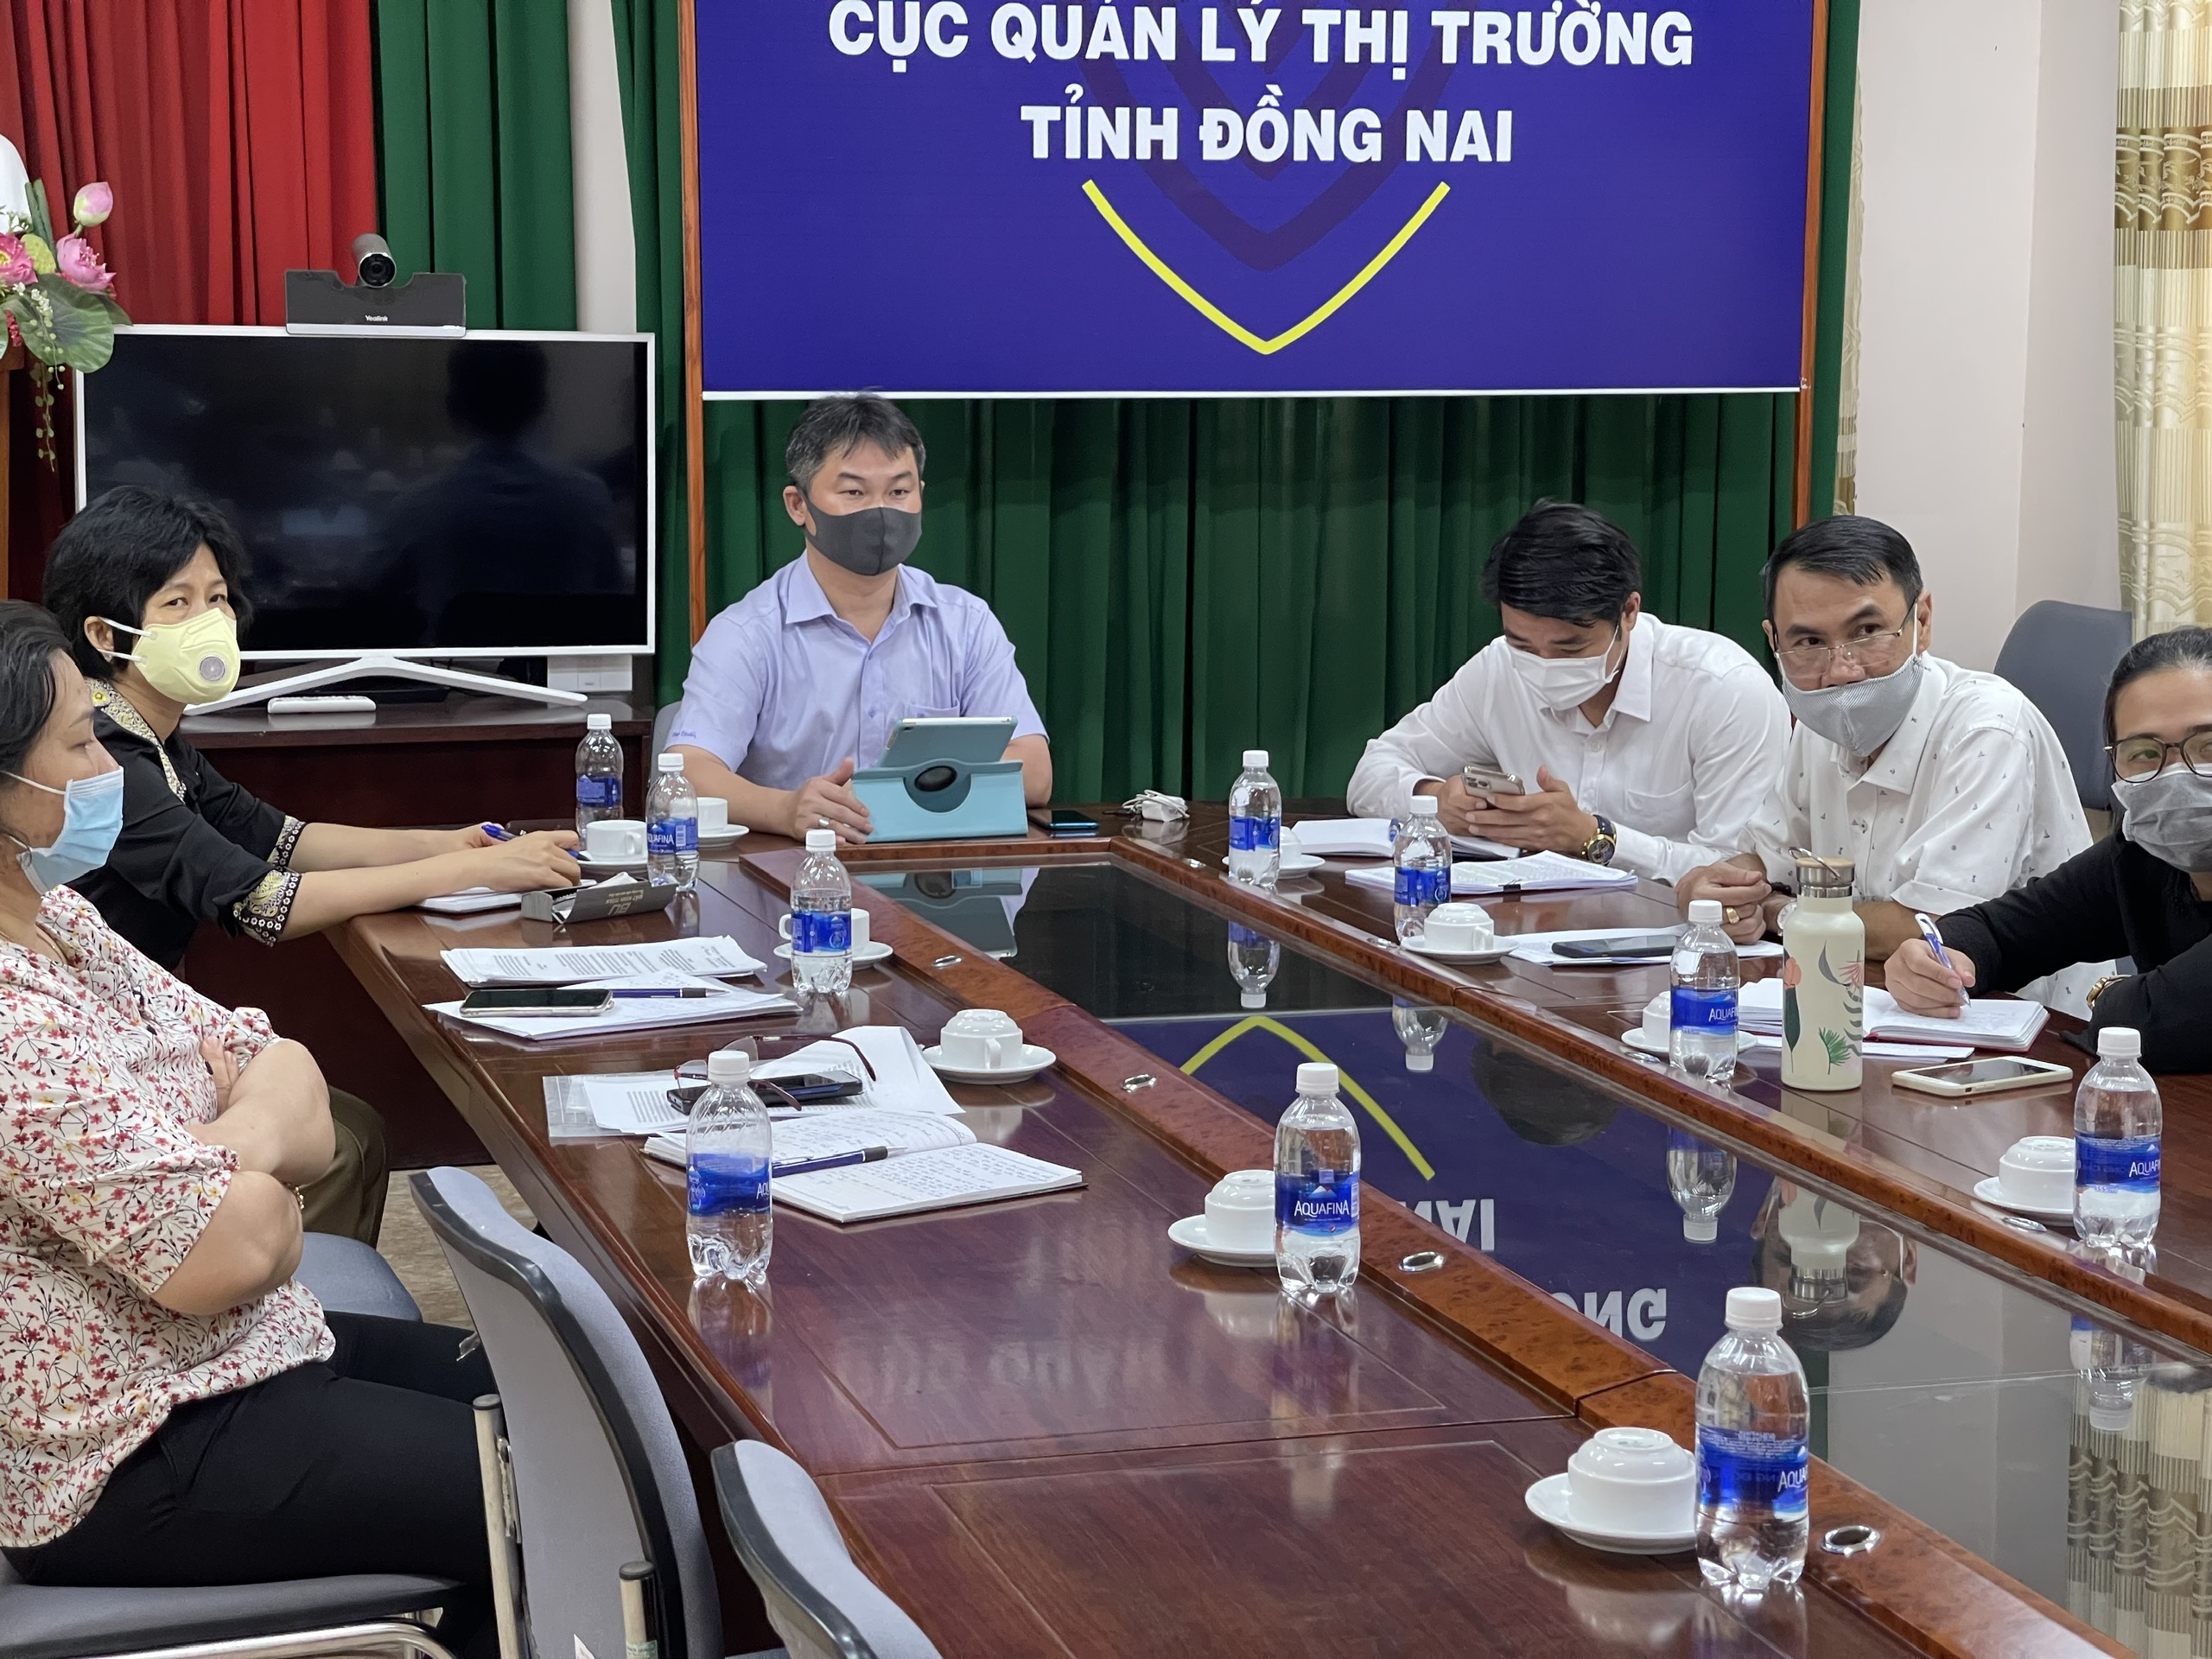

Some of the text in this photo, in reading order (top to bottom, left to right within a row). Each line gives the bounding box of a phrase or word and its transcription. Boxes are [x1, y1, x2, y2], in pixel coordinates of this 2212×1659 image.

[829, 0, 969, 73] CỤC
[1301, 9, 1408, 80] THỊ
[1431, 0, 1693, 67] TRƯỜNG
[1020, 83, 1512, 162] TỈNH ĐỒNG NAI
[1294, 1199, 1350, 1218] AQUAFINA
